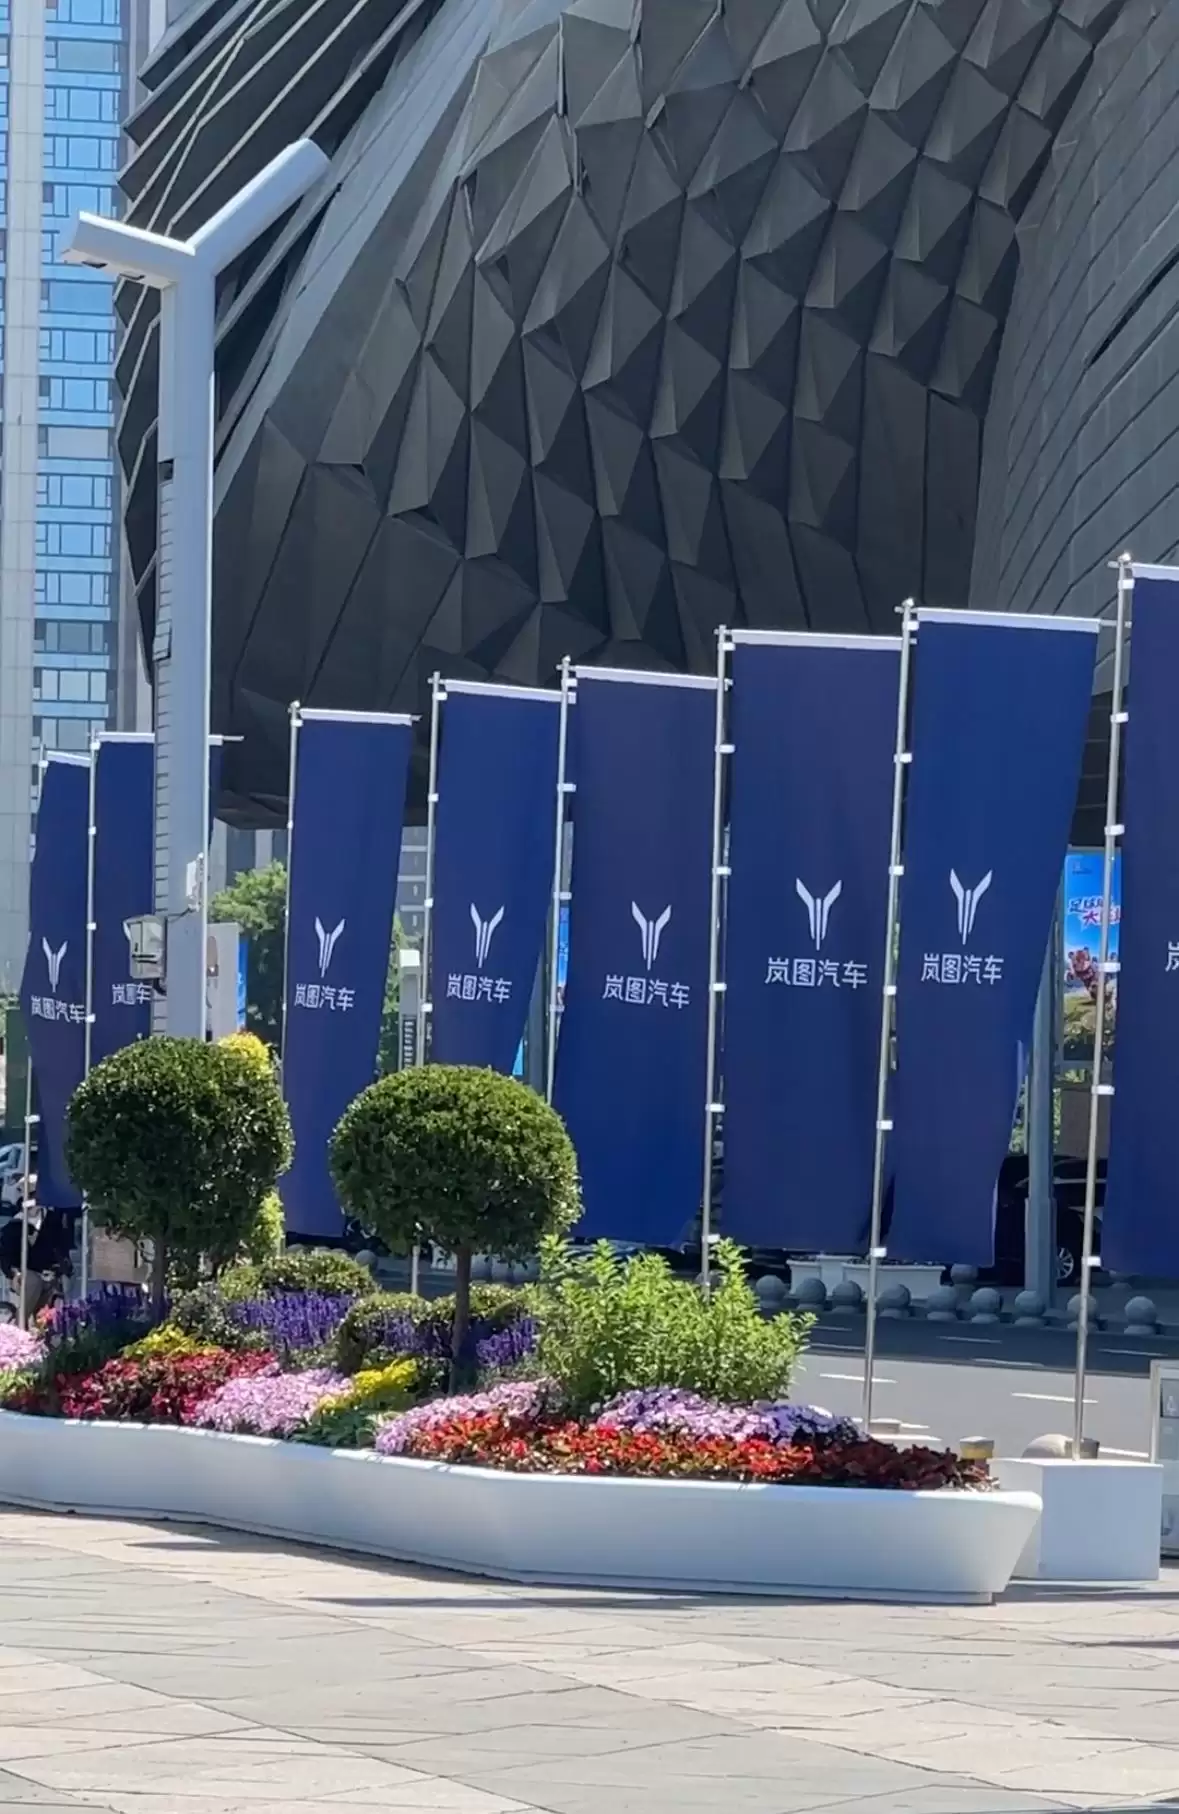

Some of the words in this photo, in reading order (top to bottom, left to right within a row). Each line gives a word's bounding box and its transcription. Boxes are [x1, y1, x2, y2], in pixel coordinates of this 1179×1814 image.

[764, 957, 868, 989] 岚图汽车
[921, 953, 1004, 985] 岚图汽车
[294, 983, 355, 1011] 岚图汽车
[446, 973, 512, 1003] 岚图汽车
[602, 974, 690, 1009] 岚图汽车
[30, 995, 85, 1023] 岚图汽车
